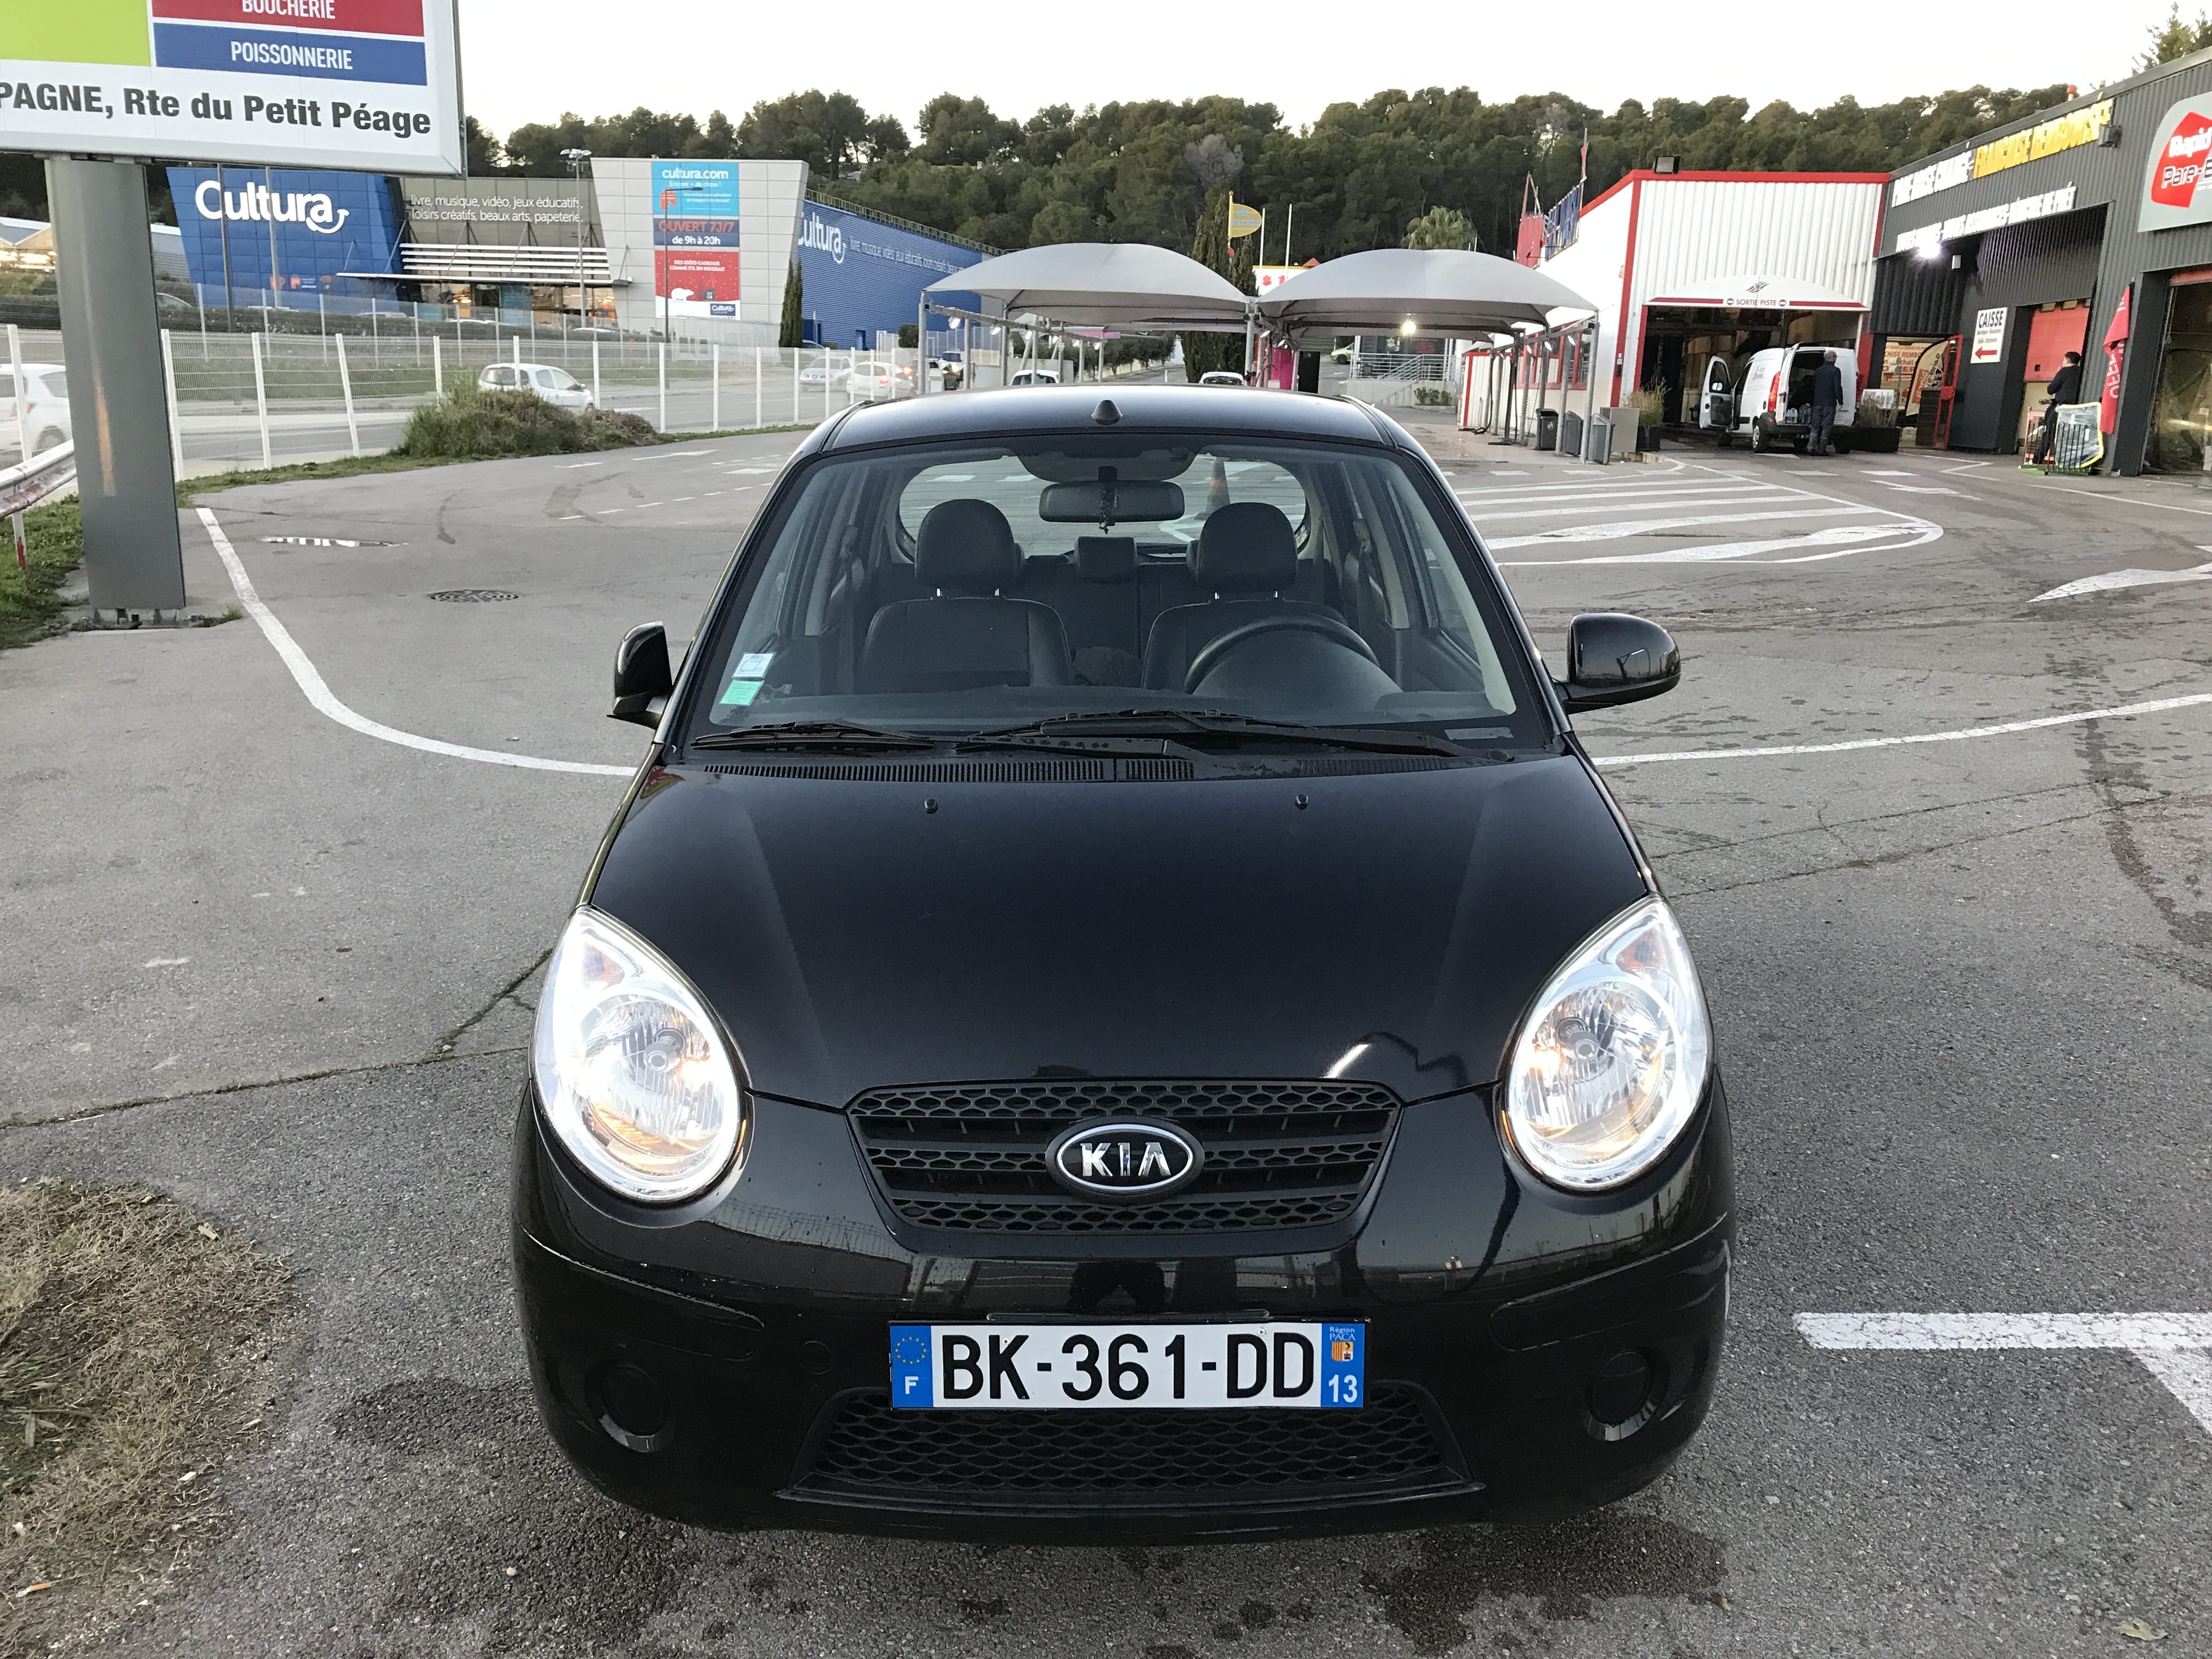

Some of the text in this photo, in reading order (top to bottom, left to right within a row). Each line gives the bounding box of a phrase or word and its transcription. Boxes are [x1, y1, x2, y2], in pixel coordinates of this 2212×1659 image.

[242, 0, 336, 19] BOUCHERIE
[230, 41, 353, 70] POISSONNERIE
[123, 88, 180, 117] Rte
[191, 92, 232, 120] du
[244, 95, 322, 127] Petit
[331, 101, 431, 139] Péage
[2169, 127, 2212, 157] Rapid
[662, 167, 729, 179] cultura.com
[195, 180, 336, 224] Cultura
[411, 194, 584, 210] livre, musique, vidéo, jeux éducatifs,
[411, 207, 439, 220] loisirs
[441, 208, 478, 222] créatifs,
[480, 210, 510, 221] beaux
[512, 211, 532, 223] arts,
[658, 221, 734, 233] OUVERT 7J/7
[672, 235, 721, 245] de 9h à 20h
[798, 212, 842, 255] ultura
[1978, 311, 2004, 328] CAISSE
[1080, 1141, 1173, 1177] KIA
[941, 1332, 1315, 1402] BK-361-DD
[904, 1376, 919, 1395] F
[1328, 1374, 1357, 1403] 13
